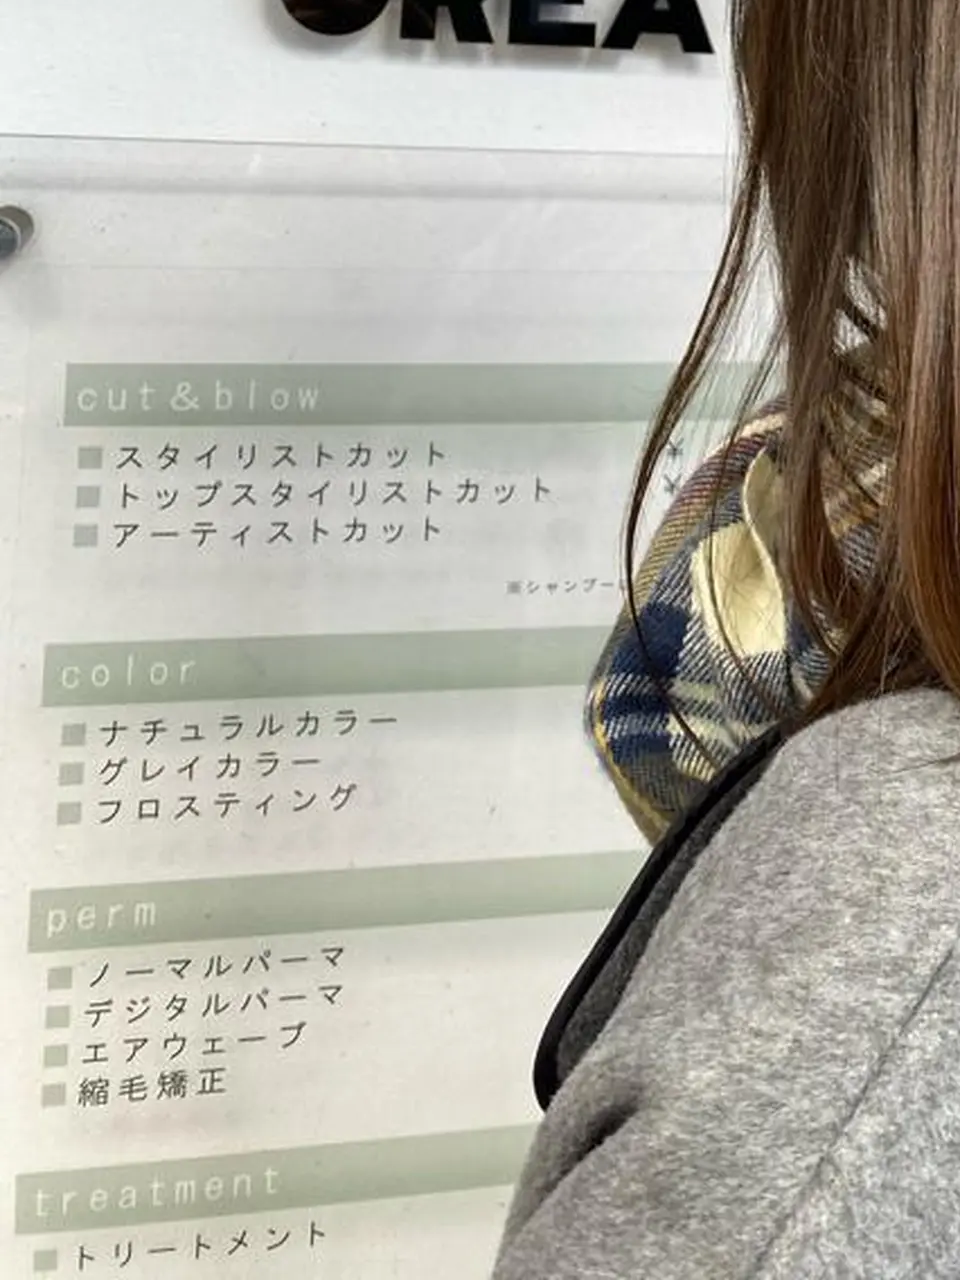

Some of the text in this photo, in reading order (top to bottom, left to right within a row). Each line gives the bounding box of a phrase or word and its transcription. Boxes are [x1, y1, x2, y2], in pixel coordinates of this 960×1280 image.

[115, 440, 445, 471] スタイリストカット
[120, 475, 551, 510] トップスタイリストカット
[113, 516, 441, 549] アーティストカット
[60, 654, 198, 690] color
[100, 709, 398, 748] ナチュラルカラー
[99, 751, 321, 786] グレイカラー
[97, 783, 358, 825] フロスティング
[46, 899, 157, 938] perm
[88, 946, 345, 989] ノーマルパーマ
[83, 984, 343, 1029] デジタルパーマ
[81, 1021, 307, 1063] エアウェーブ
[77, 1067, 227, 1108] 縮毛矯正
[35, 1164, 281, 1218] treatment
[76, 1220, 326, 1271] トリートメント
